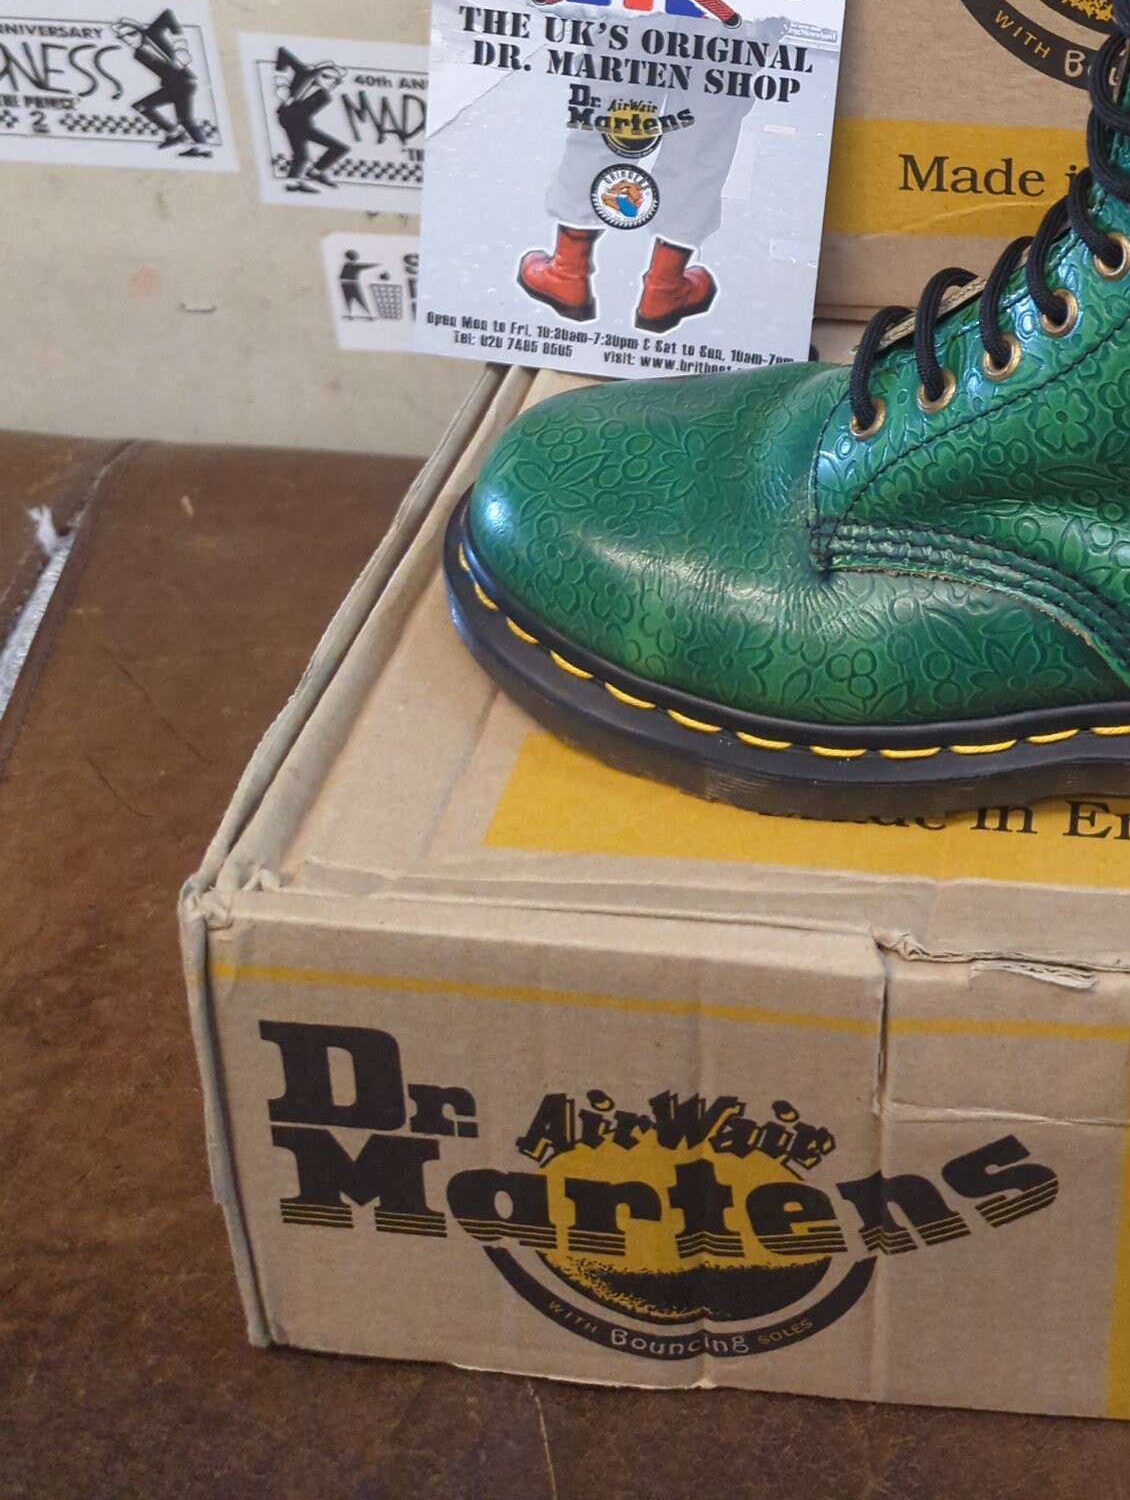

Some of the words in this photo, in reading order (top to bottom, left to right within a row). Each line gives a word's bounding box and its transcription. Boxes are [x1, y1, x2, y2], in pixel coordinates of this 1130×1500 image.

[459, 5, 531, 39] THE
[545, 16, 629, 51] UK'S
[641, 29, 813, 74] ORIGINAL
[994, 9, 1051, 59] WITH
[354, 74, 393, 88] 40th
[398, 77, 429, 90] AN
[472, 40, 531, 72] DR.
[547, 49, 692, 91] MARTEN
[704, 68, 801, 103] SHOP
[568, 83, 602, 108] Dr.
[566, 106, 696, 135] Martens
[607, 98, 659, 114] AirWair
[898, 153, 1046, 197] Made
[427, 311, 457, 328] Open
[462, 315, 488, 331] Mon
[493, 320, 506, 333] to
[655, 340, 677, 355] Sat
[682, 343, 695, 357] to
[454, 330, 476, 345] Tel:
[480, 335, 501, 349] 020
[258, 1019, 479, 1138] Dr.
[516, 1089, 837, 1182] AirWair
[271, 1125, 1060, 1257] Martens
[548, 1300, 597, 1334] WITH
[610, 1328, 750, 1356] Bouncing
[757, 1318, 814, 1345] SOLES
